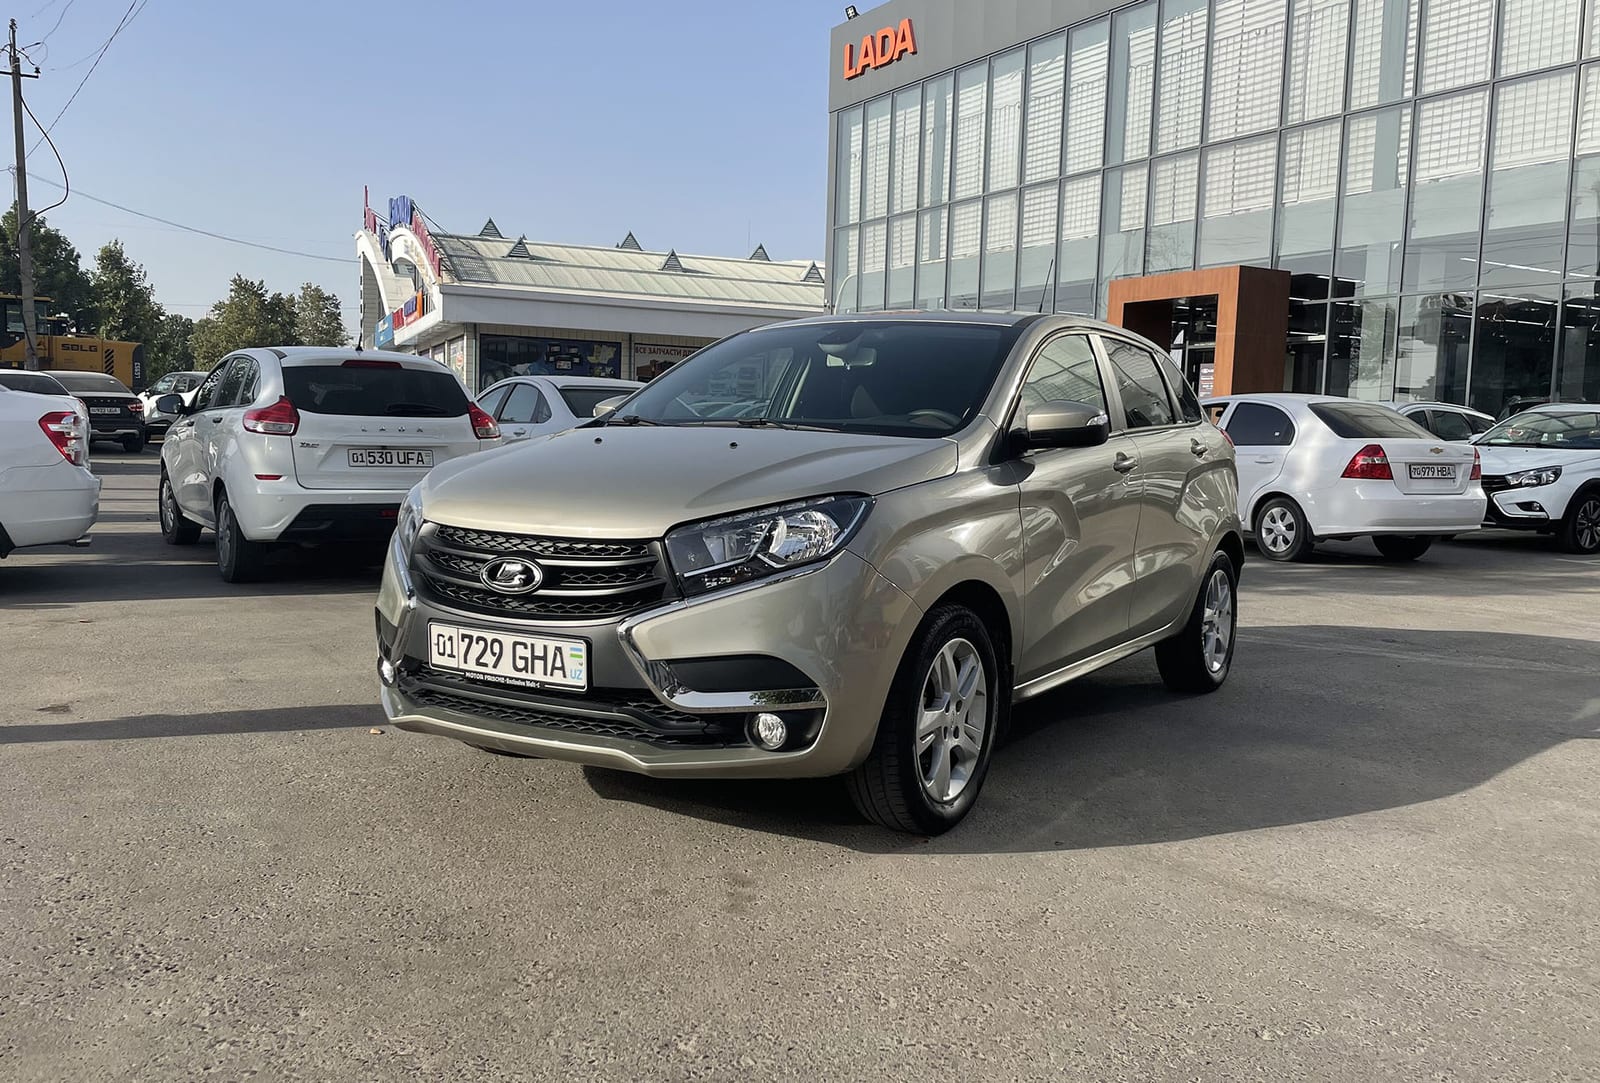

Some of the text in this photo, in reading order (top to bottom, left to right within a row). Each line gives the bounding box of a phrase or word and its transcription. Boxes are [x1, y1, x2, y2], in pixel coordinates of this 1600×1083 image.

[843, 18, 917, 81] LADA
[351, 450, 425, 465] 01 530 UFA
[1421, 466, 1436, 477] 979
[1437, 466, 1452, 477] HBA
[436, 633, 567, 679] 01 729 GHA
[569, 668, 583, 681] UZ
